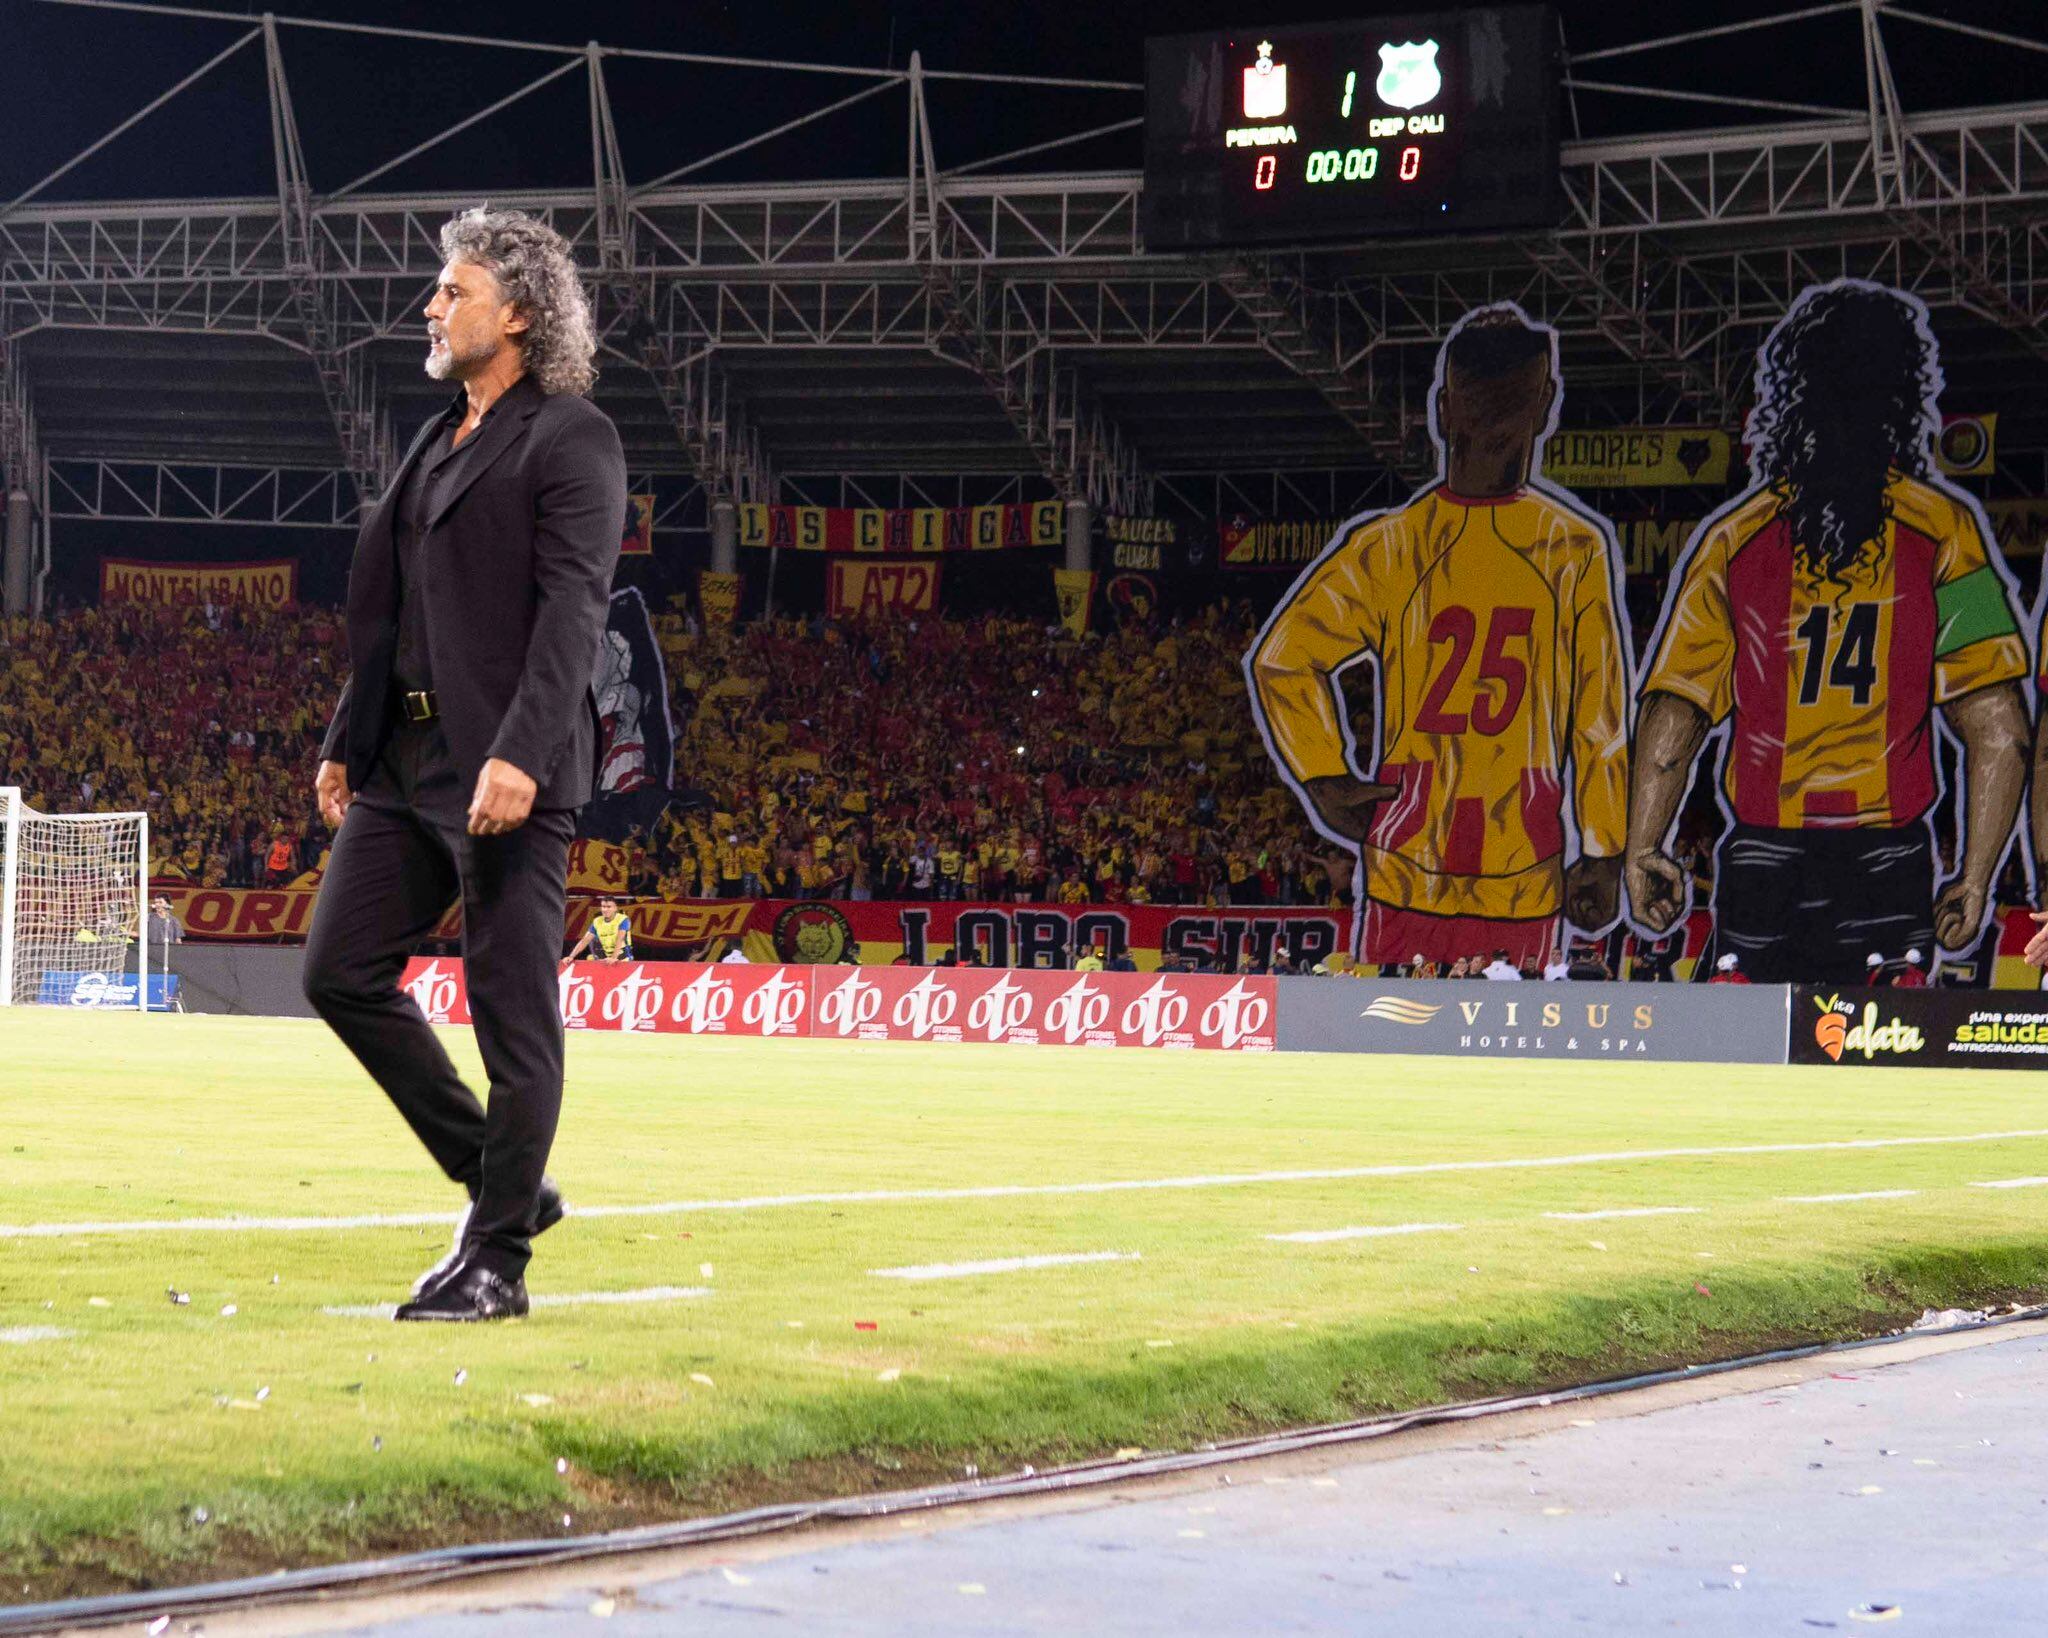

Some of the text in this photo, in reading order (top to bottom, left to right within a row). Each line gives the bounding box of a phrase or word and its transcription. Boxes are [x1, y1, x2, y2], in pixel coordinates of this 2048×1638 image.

[1226, 125, 1297, 148] PEREIRA
[1369, 114, 1445, 138] DEP CALI
[1255, 155, 1276, 190] 0
[1306, 148, 1378, 183] 00:00
[1400, 147, 1420, 181] 0
[1546, 433, 1665, 472] ADORES
[746, 506, 820, 545] LAS
[1413, 604, 1537, 737] 25
[1797, 602, 1879, 705] 14
[901, 908, 1339, 975] LOBO SUR
[1459, 1001, 1653, 1030] VISUS
[1460, 1036, 1648, 1052] HOTEL & SPA
[1947, 1041, 2048, 1055] PATROCINADORE
